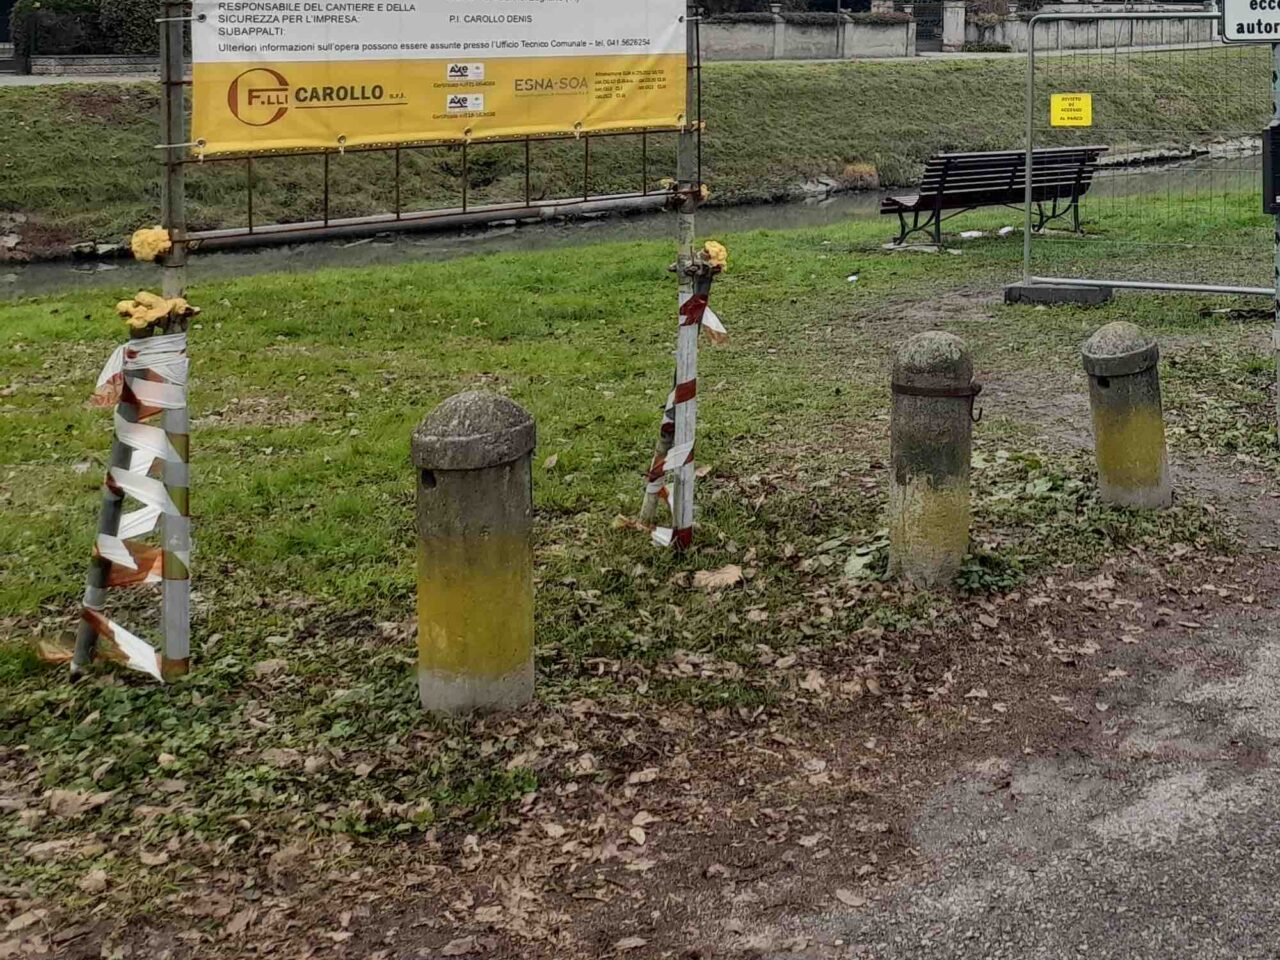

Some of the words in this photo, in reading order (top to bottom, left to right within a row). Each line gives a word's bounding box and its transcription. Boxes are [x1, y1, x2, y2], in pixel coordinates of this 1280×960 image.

[218, 2, 300, 11] RESPONSABILE
[303, 2, 323, 11] DEL
[325, 3, 374, 11] CANTIERE
[386, 3, 415, 11] DELLA
[218, 15, 280, 24] SICUREZZA
[281, 15, 302, 23] PER
[463, 15, 504, 23] CAROLLO
[506, 15, 532, 23] DENIS
[295, 84, 383, 103] CAROLLO
